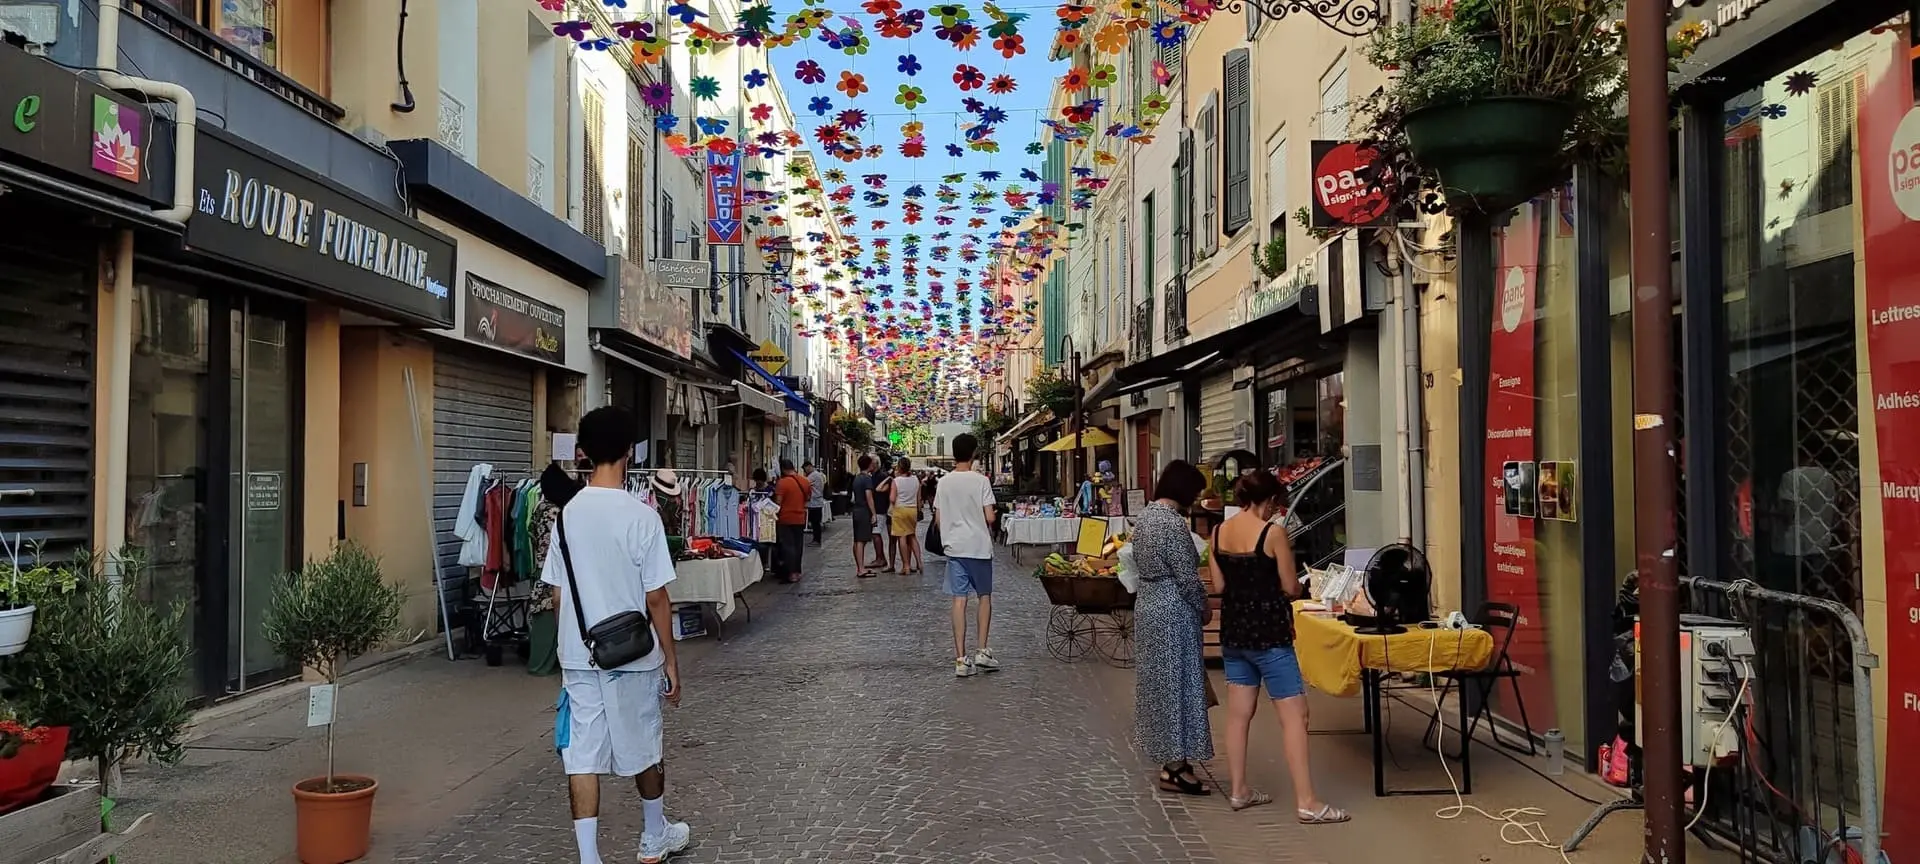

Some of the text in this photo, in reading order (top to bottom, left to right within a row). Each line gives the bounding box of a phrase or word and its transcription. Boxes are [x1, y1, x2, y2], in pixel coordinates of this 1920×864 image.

[14, 95, 41, 133] e
[198, 188, 216, 216] Ets
[221, 169, 314, 248] ROURE
[319, 209, 428, 290] FUNERAIRE
[658, 261, 706, 274] Génération
[668, 274, 696, 284] Junior
[471, 280, 563, 327] PROCHAINEMENT OUVERTURE
[1499, 375, 1521, 388] Enseigne
[1877, 390, 1920, 410] Adhés
[1487, 426, 1531, 439] Décoration vitrine
[1883, 481, 1920, 503] Marq
[1494, 542, 1526, 558] Signalétique
[1497, 562, 1524, 575] extérieure
